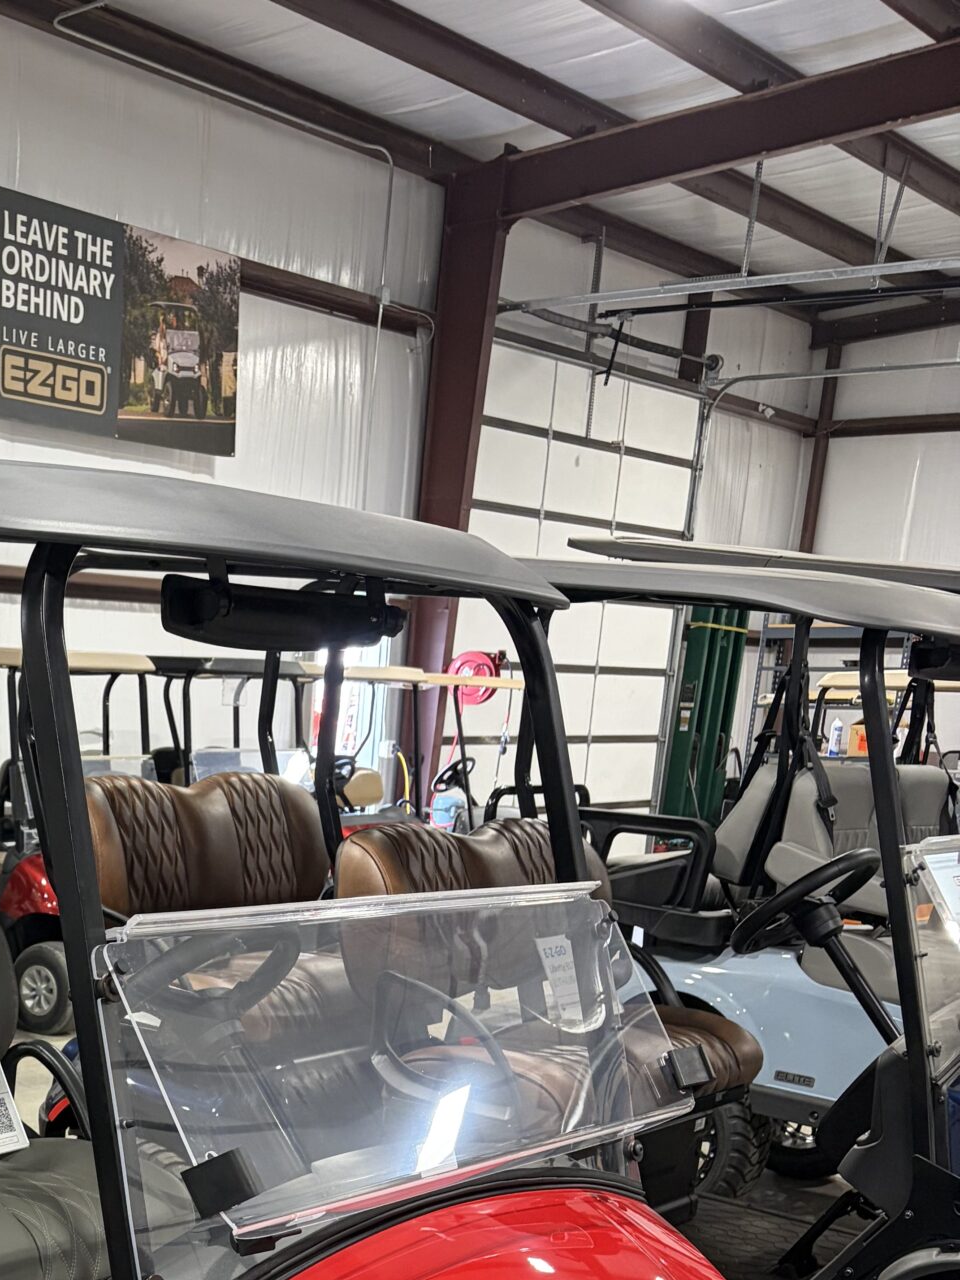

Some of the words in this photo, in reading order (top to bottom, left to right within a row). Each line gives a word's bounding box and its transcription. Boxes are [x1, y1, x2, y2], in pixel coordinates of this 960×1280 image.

[3, 210, 68, 255] LEAVE
[74, 230, 113, 268] THE
[1, 246, 115, 300] ORDINARY
[1, 278, 85, 325] BEHIND
[2, 326, 38, 348] LIVE
[48, 335, 106, 362] LARGER
